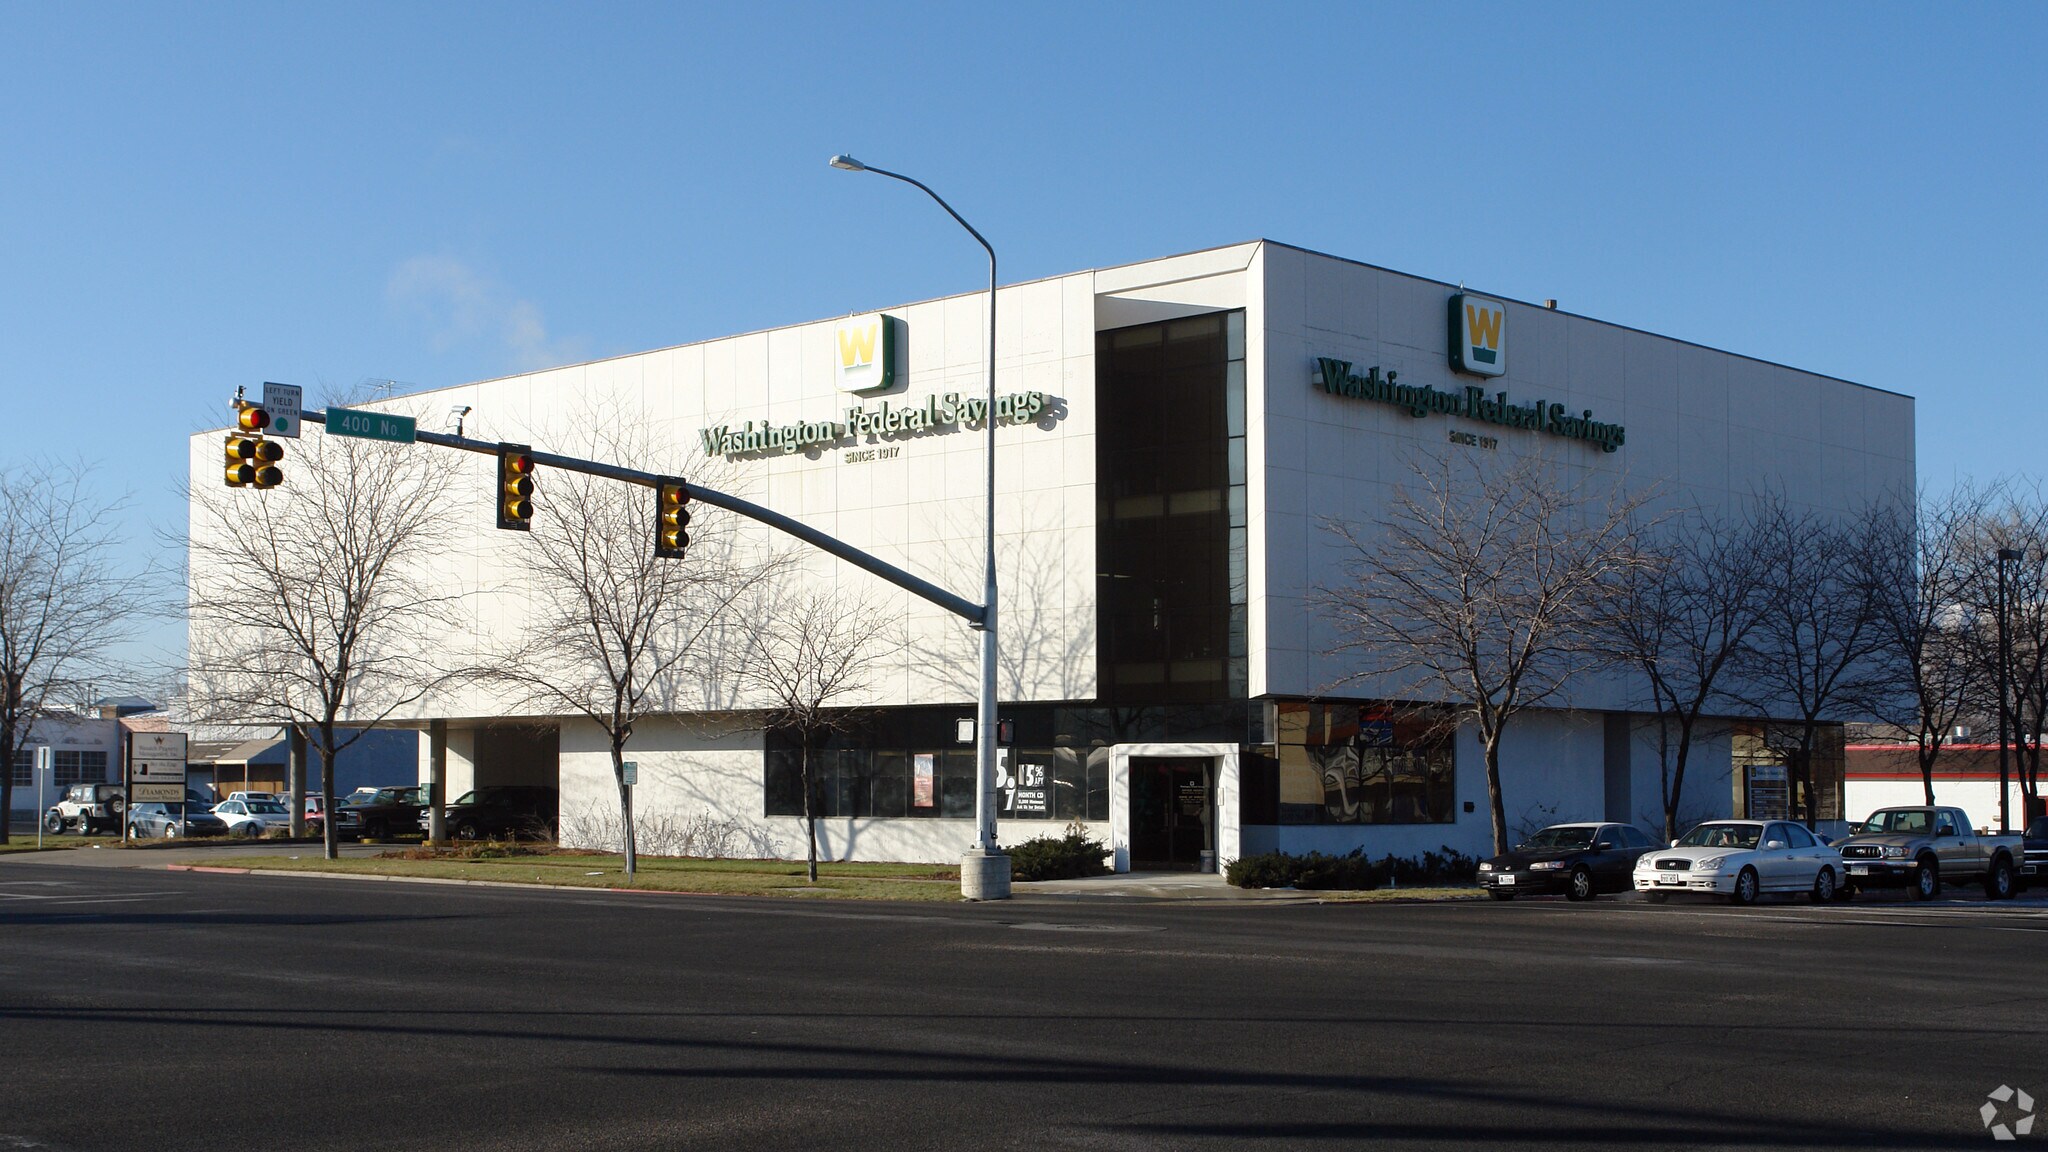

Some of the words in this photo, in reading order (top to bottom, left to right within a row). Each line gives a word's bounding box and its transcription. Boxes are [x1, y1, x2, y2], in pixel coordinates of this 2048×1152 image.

[265, 387, 280, 395] LEFT
[283, 388, 299, 396] TURN
[273, 396, 293, 406] YIELD
[1317, 357, 1464, 418] Washington
[1465, 386, 1547, 432] Federal
[1548, 403, 1625, 453] Savings
[278, 407, 298, 416] GREEN
[342, 415, 370, 433] 400
[698, 420, 836, 457] Washington
[842, 394, 936, 438] Federal
[941, 391, 1043, 425] Savngs
[1449, 430, 1477, 446] SINCE
[1479, 436, 1498, 450] 1917
[845, 449, 875, 464] SINCE
[877, 446, 900, 460] 1917
